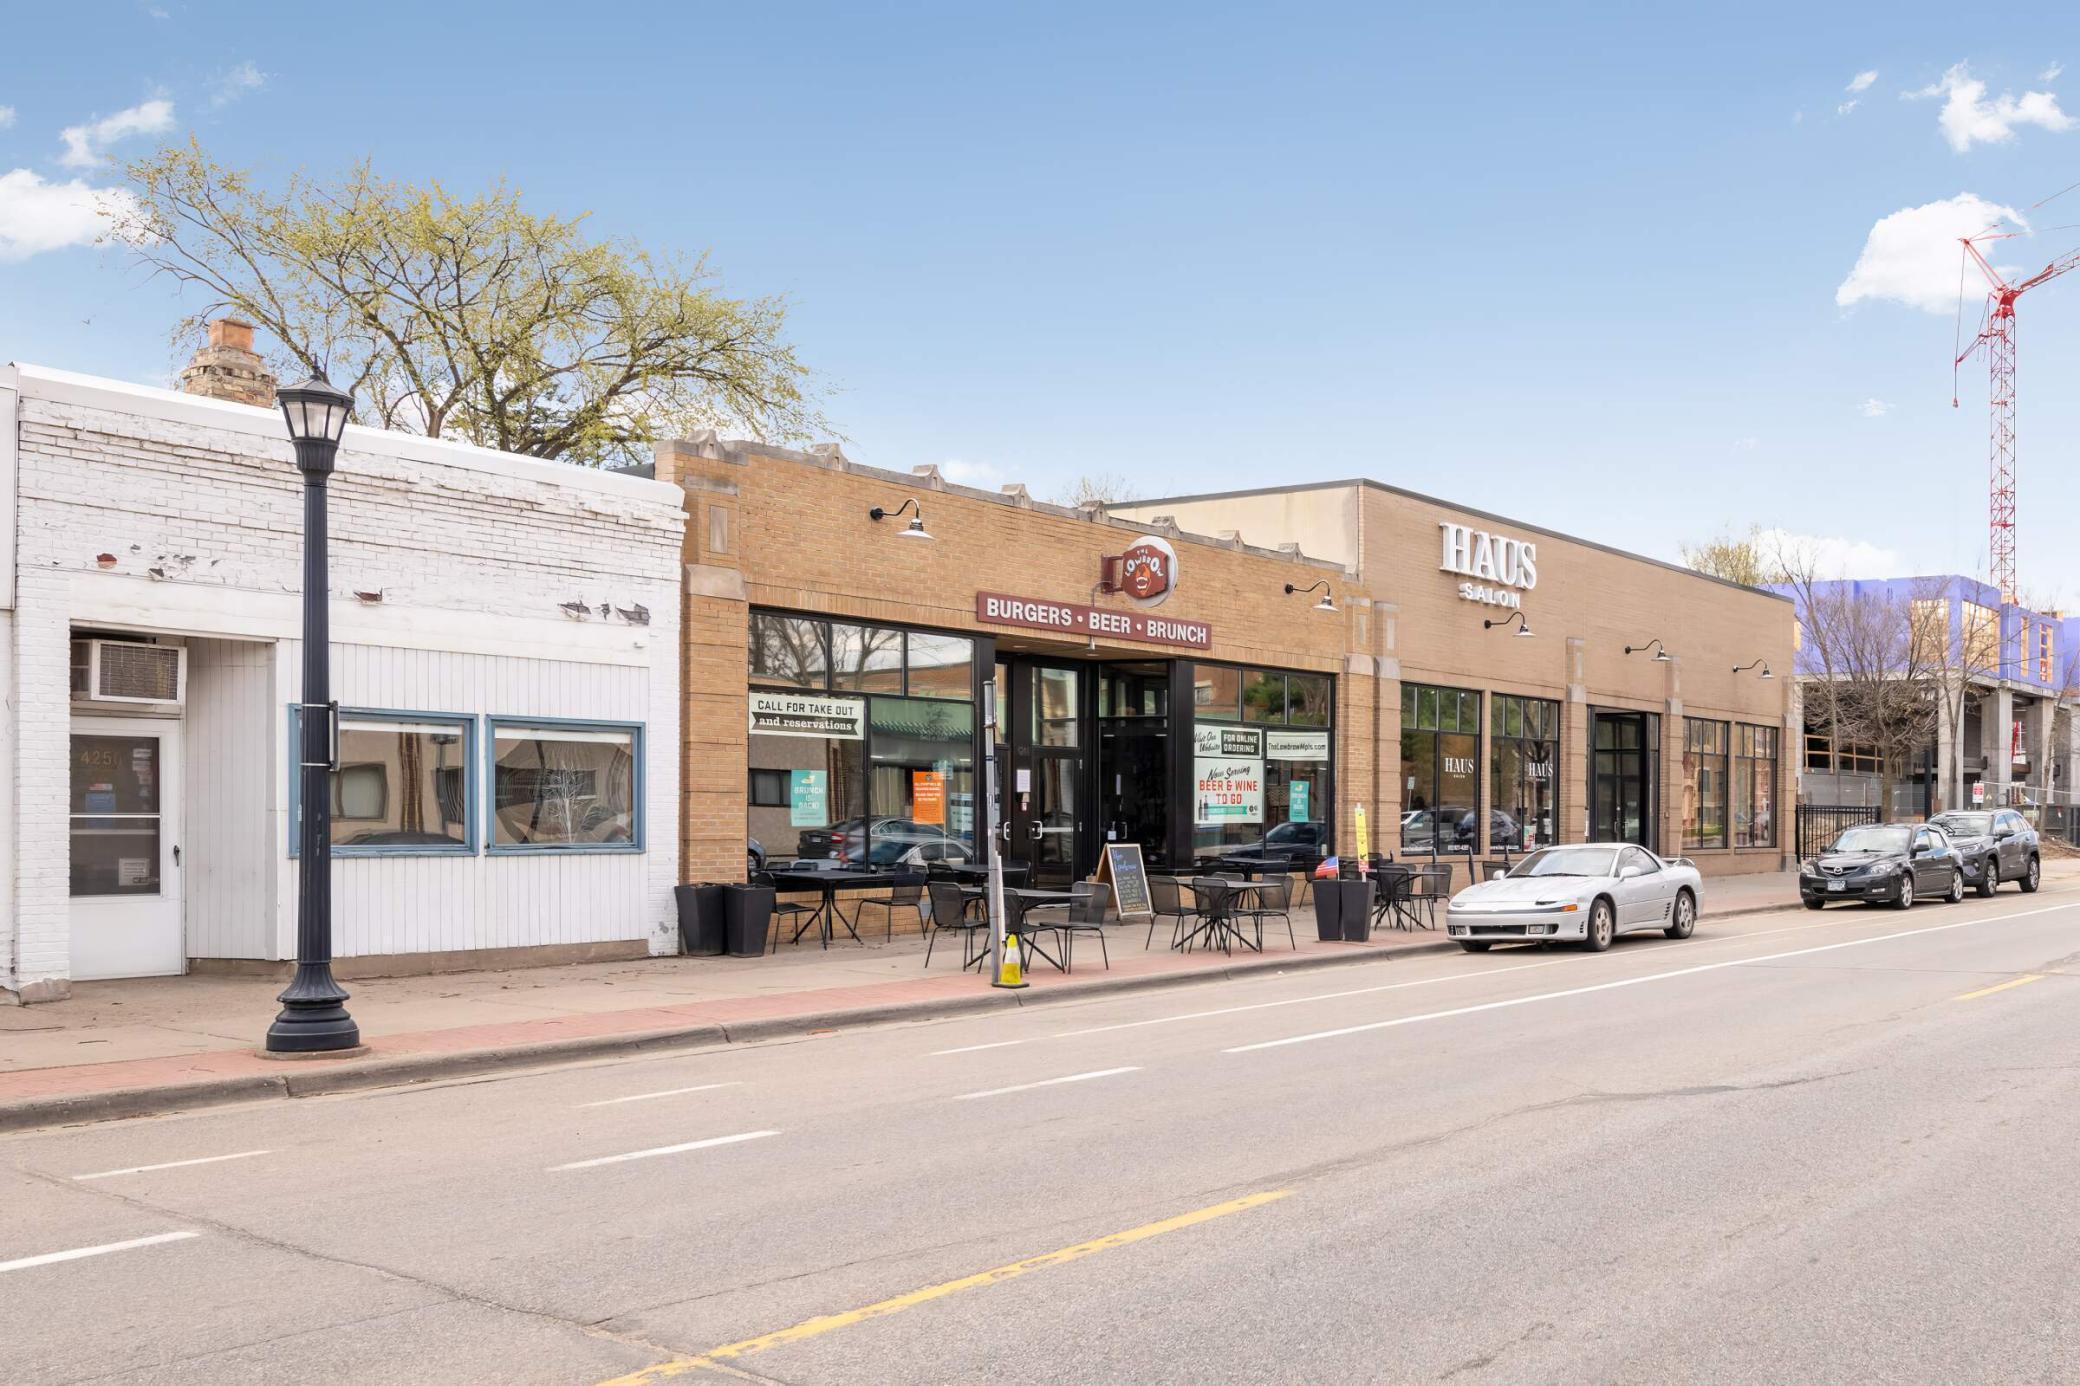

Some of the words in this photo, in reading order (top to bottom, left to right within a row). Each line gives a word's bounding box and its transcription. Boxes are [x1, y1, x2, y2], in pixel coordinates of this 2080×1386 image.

[1439, 521, 1537, 590] HAUS
[1125, 555, 1164, 577] LOWBROW
[1459, 582, 1520, 609] SALON
[987, 598, 1072, 626] BURGERS
[1089, 612, 1131, 634] BEER
[1147, 620, 1207, 643] BRUNCH
[758, 700, 783, 711] CALL
[787, 702, 805, 713] FOR
[808, 703, 832, 714] TAKE
[836, 705, 854, 716] OUT
[759, 716, 780, 726] and
[784, 719, 852, 730] reservations
[1223, 733, 1235, 742] FOR
[1236, 734, 1258, 743] ONLINE
[1223, 743, 1254, 753] ORDERING
[1444, 757, 1474, 774] HAUS
[1528, 762, 1553, 777] HAUS
[1199, 780, 1223, 791] BEER
[1226, 780, 1233, 791] &
[1235, 780, 1258, 791] WINE
[1216, 793, 1227, 804] TO
[1231, 793, 1242, 805] GO
